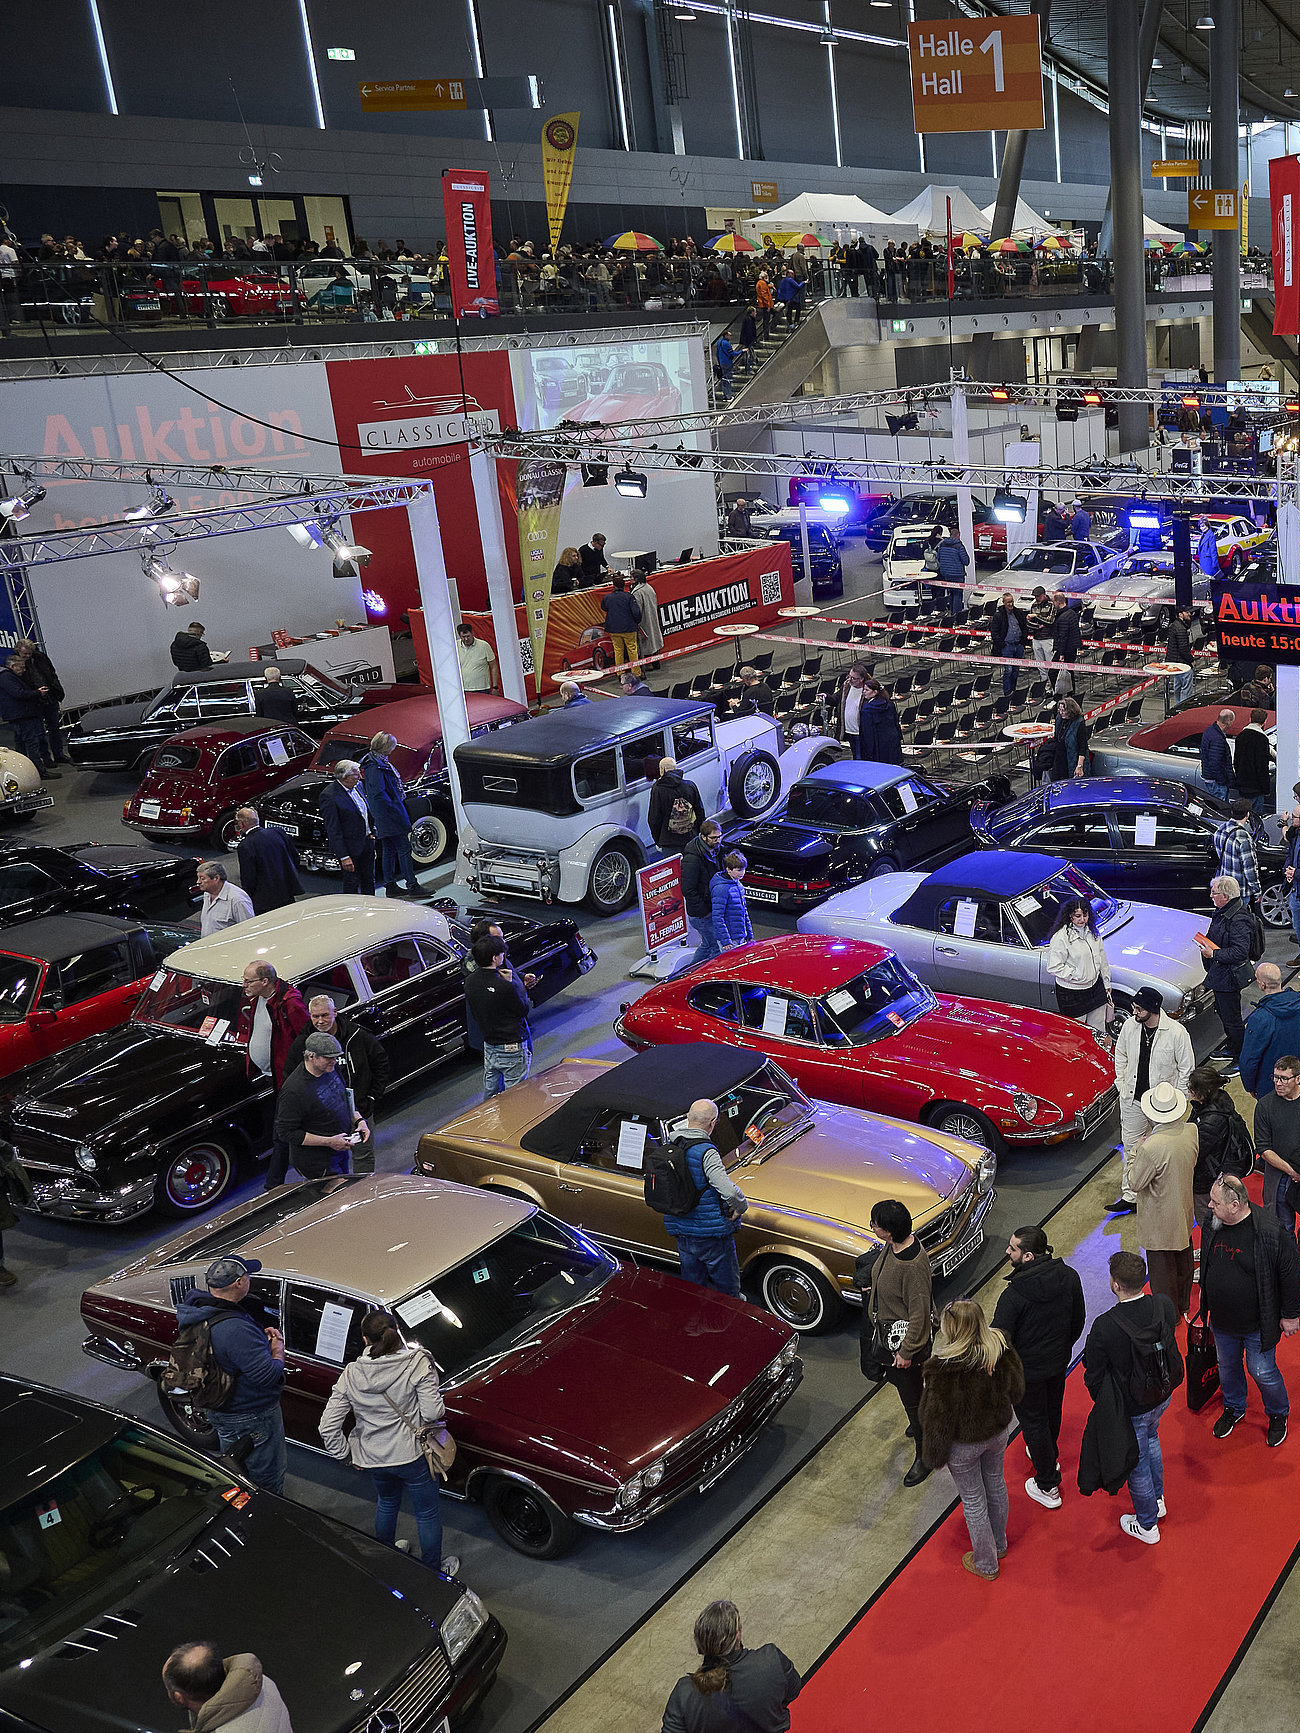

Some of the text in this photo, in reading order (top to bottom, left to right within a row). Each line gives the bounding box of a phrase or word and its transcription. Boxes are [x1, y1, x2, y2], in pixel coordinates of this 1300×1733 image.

[918, 29, 1006, 93] Halle 1
[374, 84, 395, 92] Service
[921, 71, 963, 96] Hall
[461, 203, 479, 289] LIVE-AUKTION
[40, 403, 305, 474] Auktion
[366, 416, 495, 448] CLASSICBD
[412, 452, 461, 468] automobile
[519, 467, 564, 482] DONAU CLASSIC
[660, 581, 749, 627] LIVE-AUKTION
[1221, 632, 1266, 648] heute
[645, 877, 679, 900] LIVE-AUKTION
[745, 889, 776, 900] LASSICBID
[659, 920, 684, 938] FEBRUAR
[945, 1235, 981, 1271] CLASSICBID
[1213, 1240, 1243, 1260] Hugo
[477, 1270, 484, 1280] 5
[46, 1513, 54, 1524] 4
